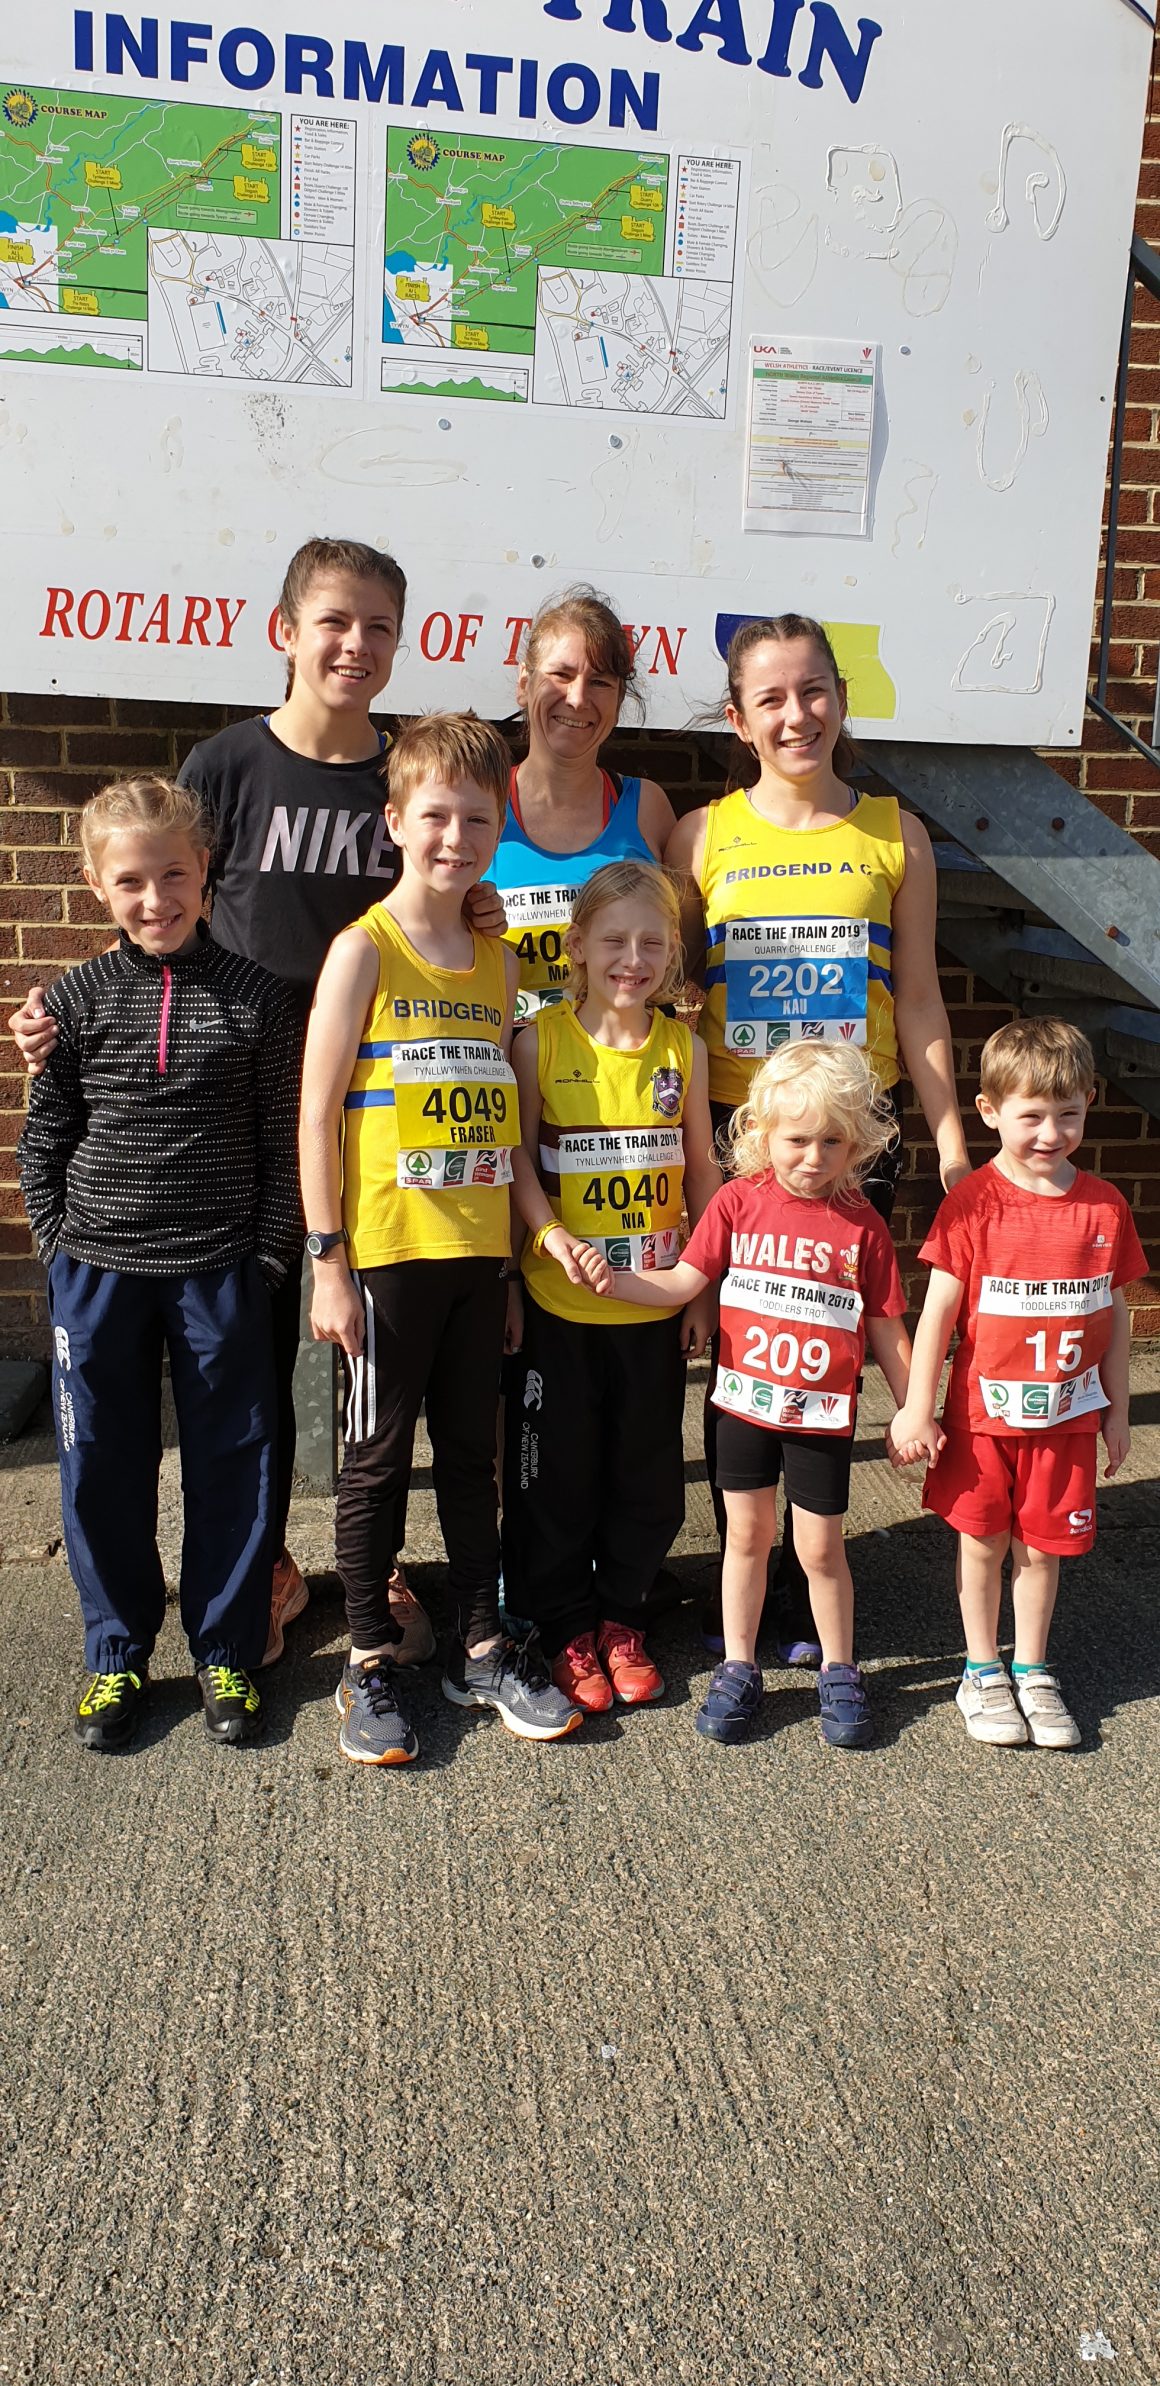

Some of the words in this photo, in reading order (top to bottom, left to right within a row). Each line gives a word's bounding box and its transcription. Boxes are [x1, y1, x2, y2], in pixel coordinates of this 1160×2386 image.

[74, 10, 660, 131] INFORMATION
[41, 106, 82, 116] COURSE
[85, 110, 107, 119] MAP
[443, 149, 481, 160] COURSE
[484, 152, 505, 161] MAP
[38, 587, 246, 648] ROTARY
[420, 612, 483, 663] OF
[259, 806, 395, 879] NIKE
[726, 862, 832, 884] BRIDGEND
[840, 862, 853, 874] A
[860, 864, 872, 876] C
[505, 894, 526, 907] ACE
[529, 891, 552, 905] THE
[732, 928, 761, 941] RACE
[766, 927, 787, 940] THE
[791, 926, 827, 939] TRAIN
[831, 925, 860, 938] 2019
[754, 946, 787, 955] QUARRY
[789, 945, 836, 953] CHALLENGE
[749, 963, 844, 998] 2202
[394, 999, 502, 1027] BRIDGEND
[783, 999, 808, 1015] KAU
[402, 1047, 436, 1061] RACE
[440, 1046, 461, 1060] THE
[464, 1046, 490, 1060] TRAIN
[414, 1067, 472, 1076] TYNLLWYNHEN
[473, 1066, 506, 1077] CHALLENGE
[422, 1087, 507, 1123] 4049
[451, 1126, 496, 1144] FRASER
[565, 1138, 595, 1153] RACE
[599, 1137, 621, 1150] THE
[625, 1134, 658, 1149] TRAIN
[660, 1133, 678, 1147] 2019
[575, 1156, 636, 1167] TYNLLWYNHEN
[637, 1152, 674, 1163] CHALLENGE
[583, 1172, 669, 1211] 4040
[621, 1212, 645, 1230] NIA
[731, 1232, 832, 1273] WALES
[731, 1275, 760, 1292] RACE
[765, 1281, 786, 1298] THE
[791, 1286, 825, 1304] TRAIN
[828, 1293, 855, 1311] 2019
[990, 1280, 1019, 1295] RACE
[1025, 1282, 1048, 1296] THE
[1052, 1281, 1090, 1295] TRAIN
[759, 1299, 802, 1315] TODDLERS
[804, 1307, 826, 1319] TROT
[1021, 1301, 1067, 1311] TODDLERS
[1069, 1300, 1090, 1310] TROT
[742, 1325, 831, 1382] 209
[1025, 1330, 1084, 1372] 15
[522, 1434, 530, 1451] NEW
[530, 1433, 539, 1478] CANTERBURY
[521, 1452, 529, 1490] ZEALAND
